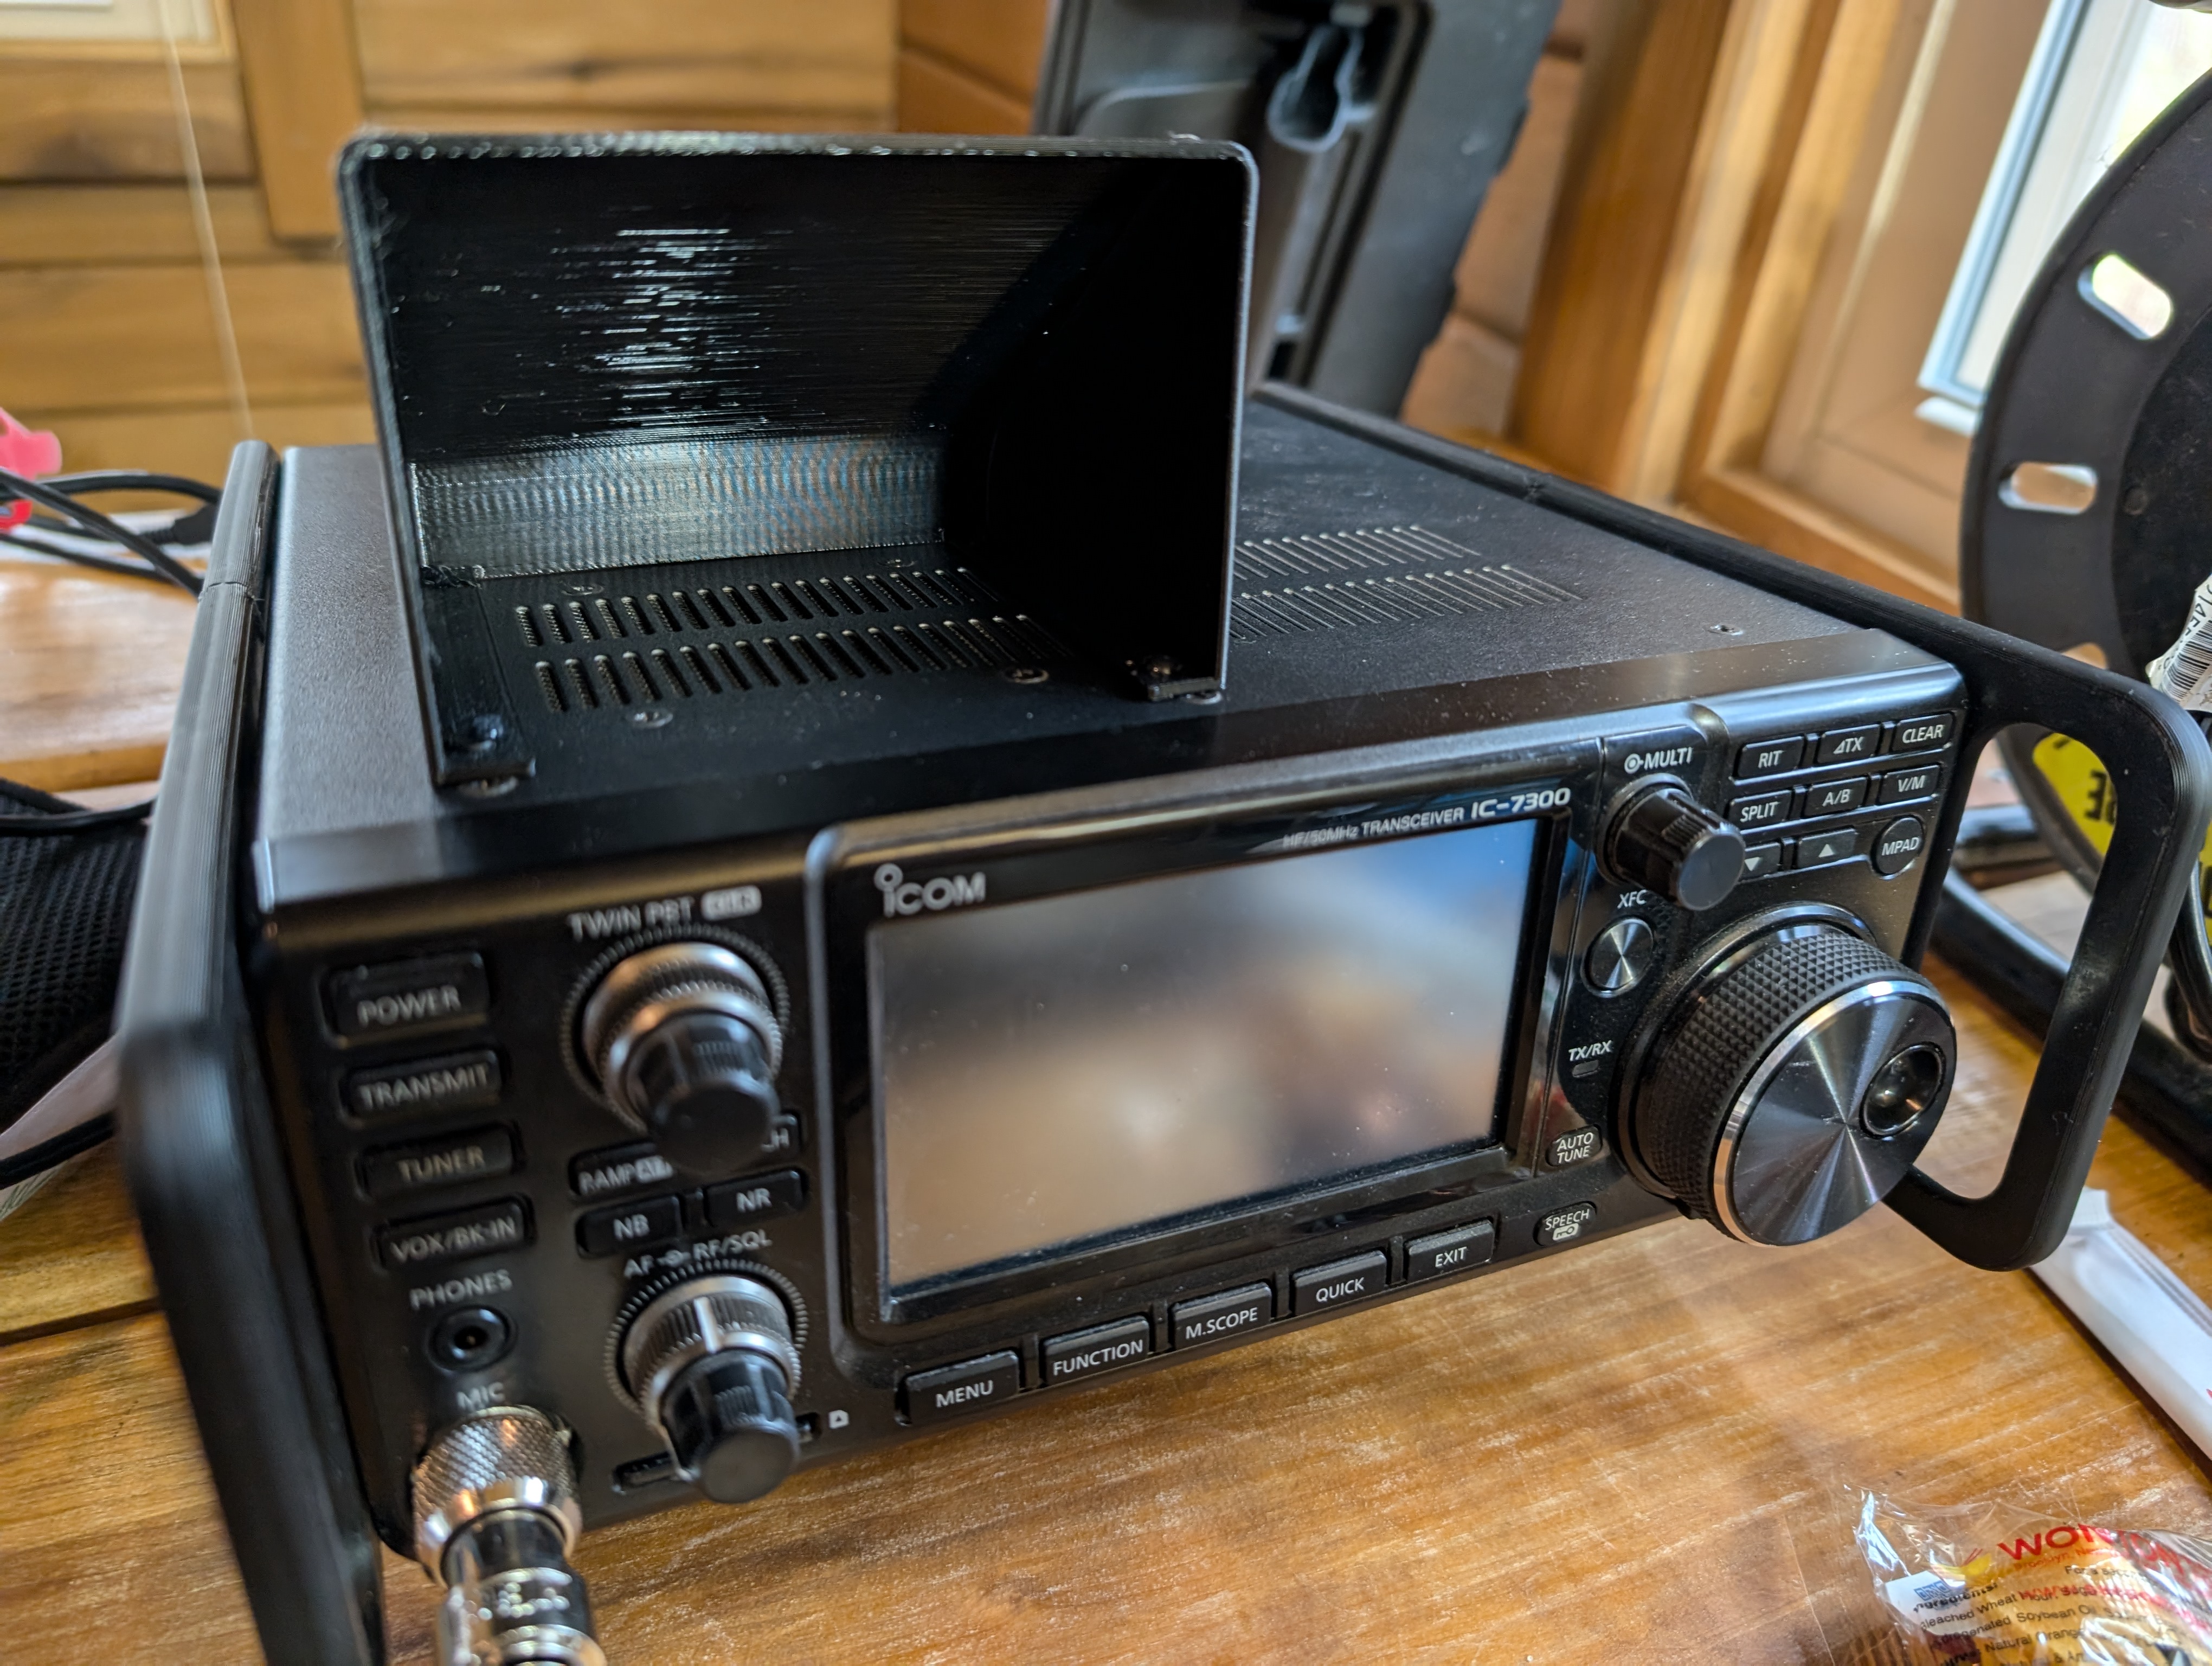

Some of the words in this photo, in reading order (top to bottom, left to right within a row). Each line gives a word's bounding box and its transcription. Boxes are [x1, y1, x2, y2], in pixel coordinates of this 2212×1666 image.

[1902, 724, 1945, 744] CLEAR
[1643, 747, 1693, 771] MULTI
[1758, 749, 1784, 768] RIT
[1898, 775, 1925, 793] V/M
[1822, 789, 1850, 806] A/B
[1282, 823, 1358, 849] HF/50MHz
[1361, 806, 1464, 837] TRANSCEIVER
[1471, 786, 1571, 820] IC-7300
[1740, 801, 1778, 821] SPLIT
[1881, 837, 1919, 856] MPAD
[1617, 889, 1647, 909] XFC
[567, 903, 642, 942] TWIN
[357, 984, 462, 1028] POWER
[1568, 1040, 1612, 1061] TX/RX
[358, 1062, 490, 1112] TRANSMIT
[1557, 1132, 1593, 1152] AUTO
[1557, 1145, 1590, 1164] TUNE
[396, 1145, 485, 1183] TUNER
[736, 1188, 771, 1214] NR
[613, 1214, 649, 1241] NB
[1544, 1208, 1590, 1231] SPEECH
[390, 1216, 517, 1263] VOX/BK-IN
[624, 1254, 654, 1279] AF
[693, 1228, 773, 1262] RF/SQL
[1435, 1246, 1468, 1268] EXIT
[409, 1269, 512, 1310] PHONES
[1316, 1277, 1365, 1303] QUICK
[1185, 1306, 1258, 1340] M.SCOPE
[1052, 1338, 1143, 1376] FUNCTION
[456, 1381, 505, 1410] MIC
[935, 1380, 994, 1408] MENU
[1976, 1592, 2018, 1615] Wheat
[2016, 1608, 2077, 1623] Soybean
